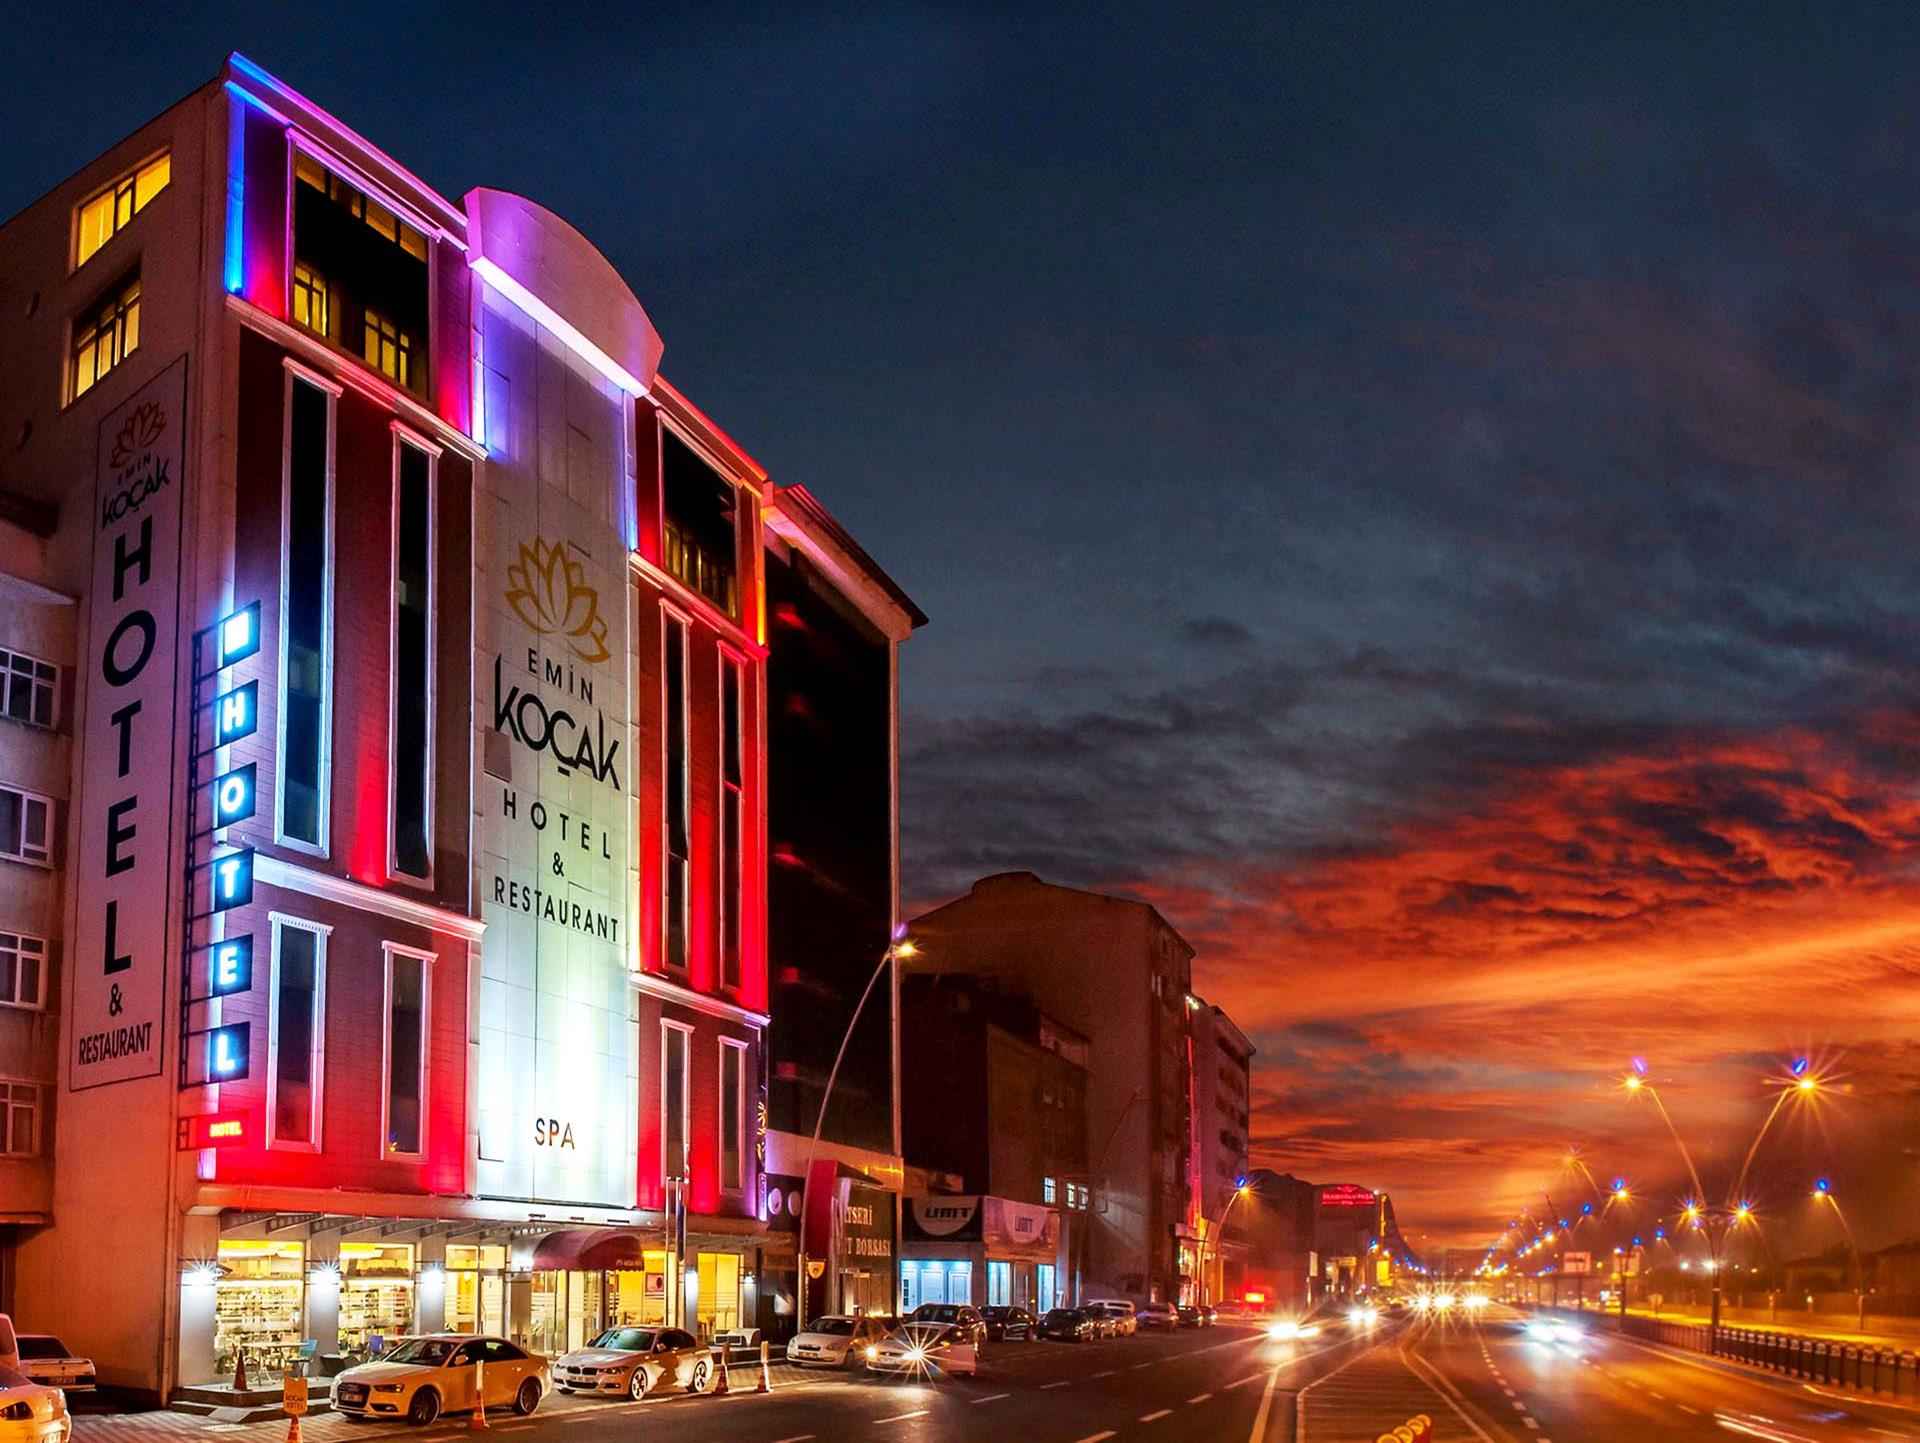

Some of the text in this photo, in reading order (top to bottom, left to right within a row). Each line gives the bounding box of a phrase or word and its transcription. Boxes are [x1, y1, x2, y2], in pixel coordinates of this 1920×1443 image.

[102, 456, 170, 528] KOÇAK
[528, 648, 593, 704] EMİN
[103, 515, 156, 975] HOTEL
[495, 653, 620, 791] KOÇAK
[504, 788, 611, 859] HOTEL
[216, 691, 246, 1073] HOTEL
[553, 852, 564, 876] &
[495, 876, 618, 942] RESTAURANT
[110, 983, 122, 1016] &
[79, 1022, 152, 1065] RESTAURANT
[535, 1118, 575, 1150] SPA
